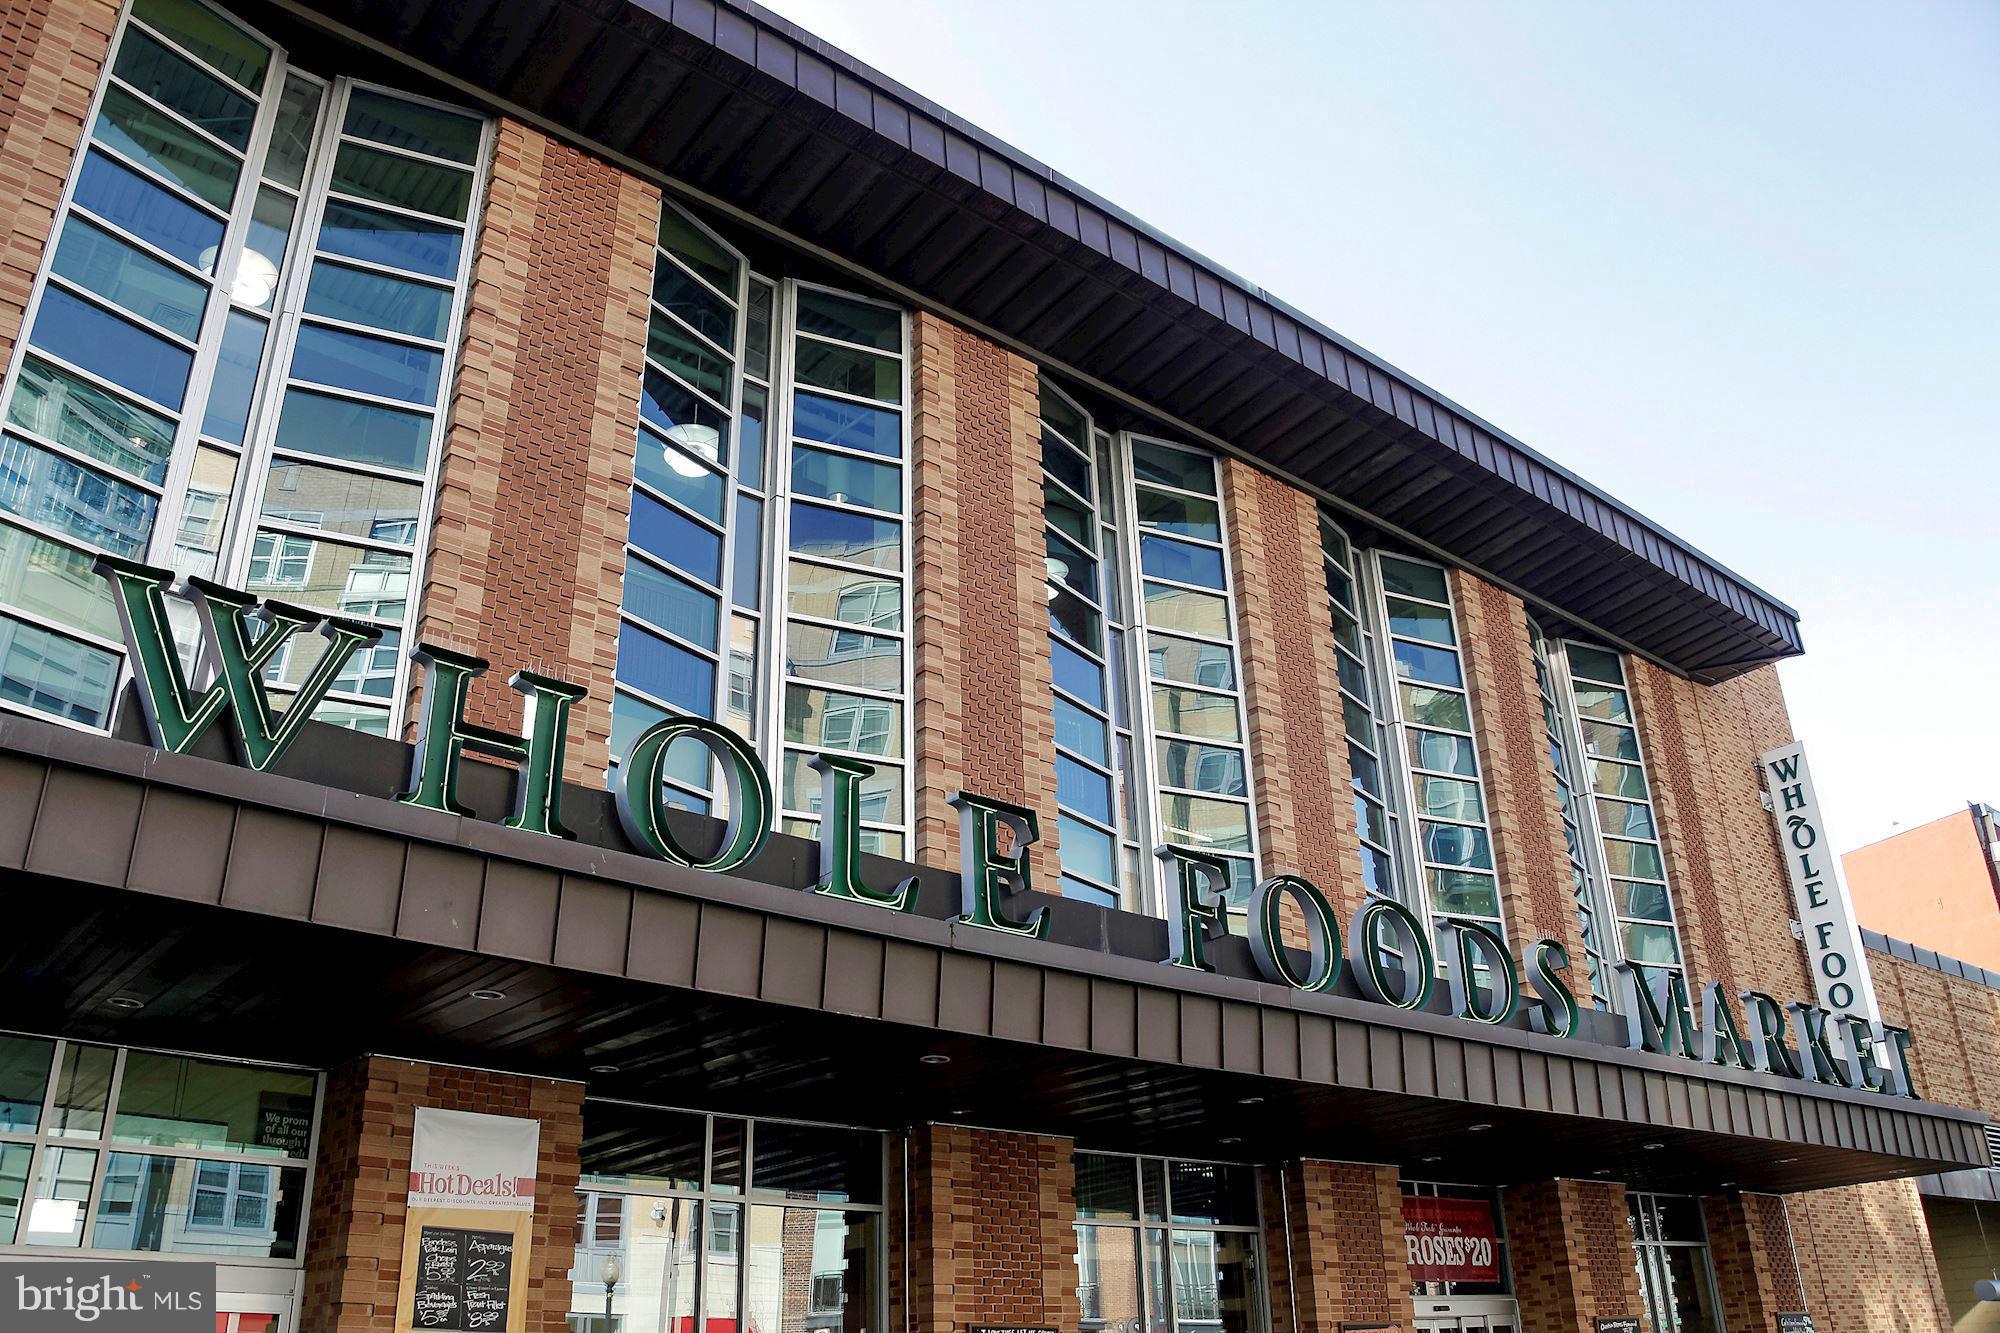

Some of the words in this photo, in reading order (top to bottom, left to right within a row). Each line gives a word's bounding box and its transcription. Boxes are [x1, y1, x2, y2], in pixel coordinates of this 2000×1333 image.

[92, 553, 1052, 940] WHOLE
[1154, 843, 1579, 1039] FOODS
[1614, 958, 1921, 1101] MARKET
[1769, 753, 1828, 911] WHOLE
[1815, 921, 1854, 1009] FOO
[265, 1112, 280, 1123] We
[282, 1116, 309, 1127] prom
[265, 1123, 277, 1133] of
[277, 1125, 289, 1135] all
[262, 1134, 301, 1149] through
[418, 1171, 454, 1195] Hot
[455, 1173, 518, 1198] Deals!
[1404, 1235, 1465, 1266] ROSES
[1464, 1236, 1492, 1266] $20
